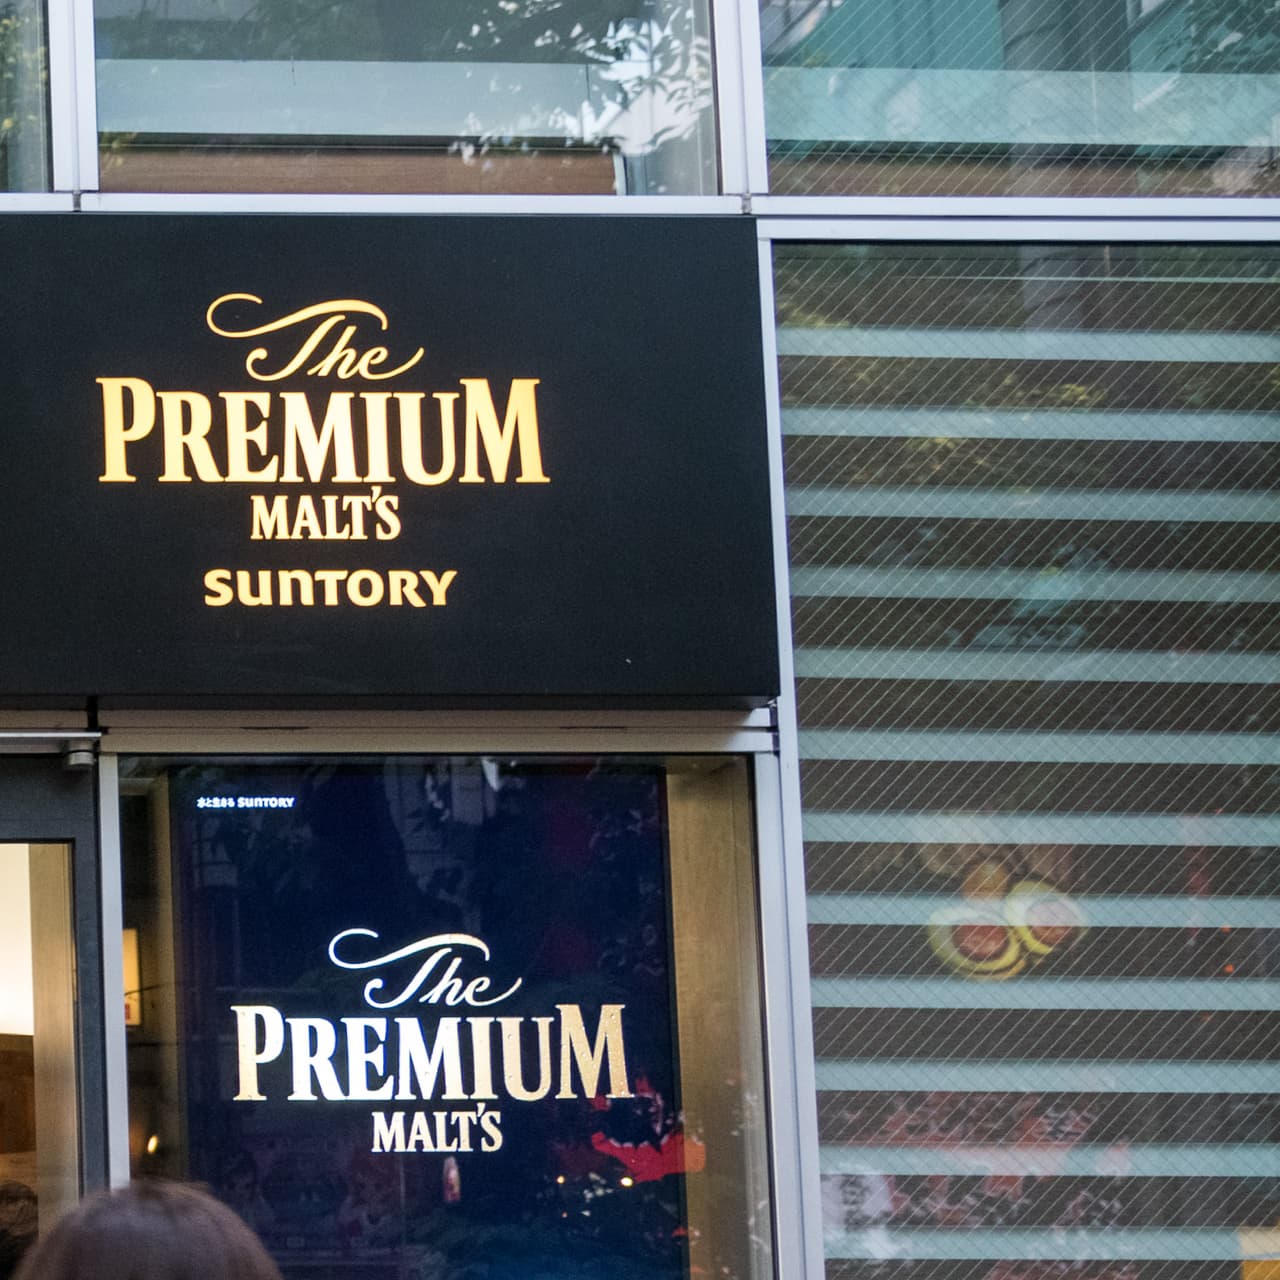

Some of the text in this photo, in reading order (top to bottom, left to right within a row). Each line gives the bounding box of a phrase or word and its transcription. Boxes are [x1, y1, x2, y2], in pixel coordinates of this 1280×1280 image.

[207, 294, 424, 377] The
[96, 374, 550, 485] PREMIUM
[251, 488, 401, 540] MALT'S
[329, 928, 522, 1008] The
[231, 1004, 634, 1101] PREMIUM
[371, 1102, 503, 1153] MALT'S
